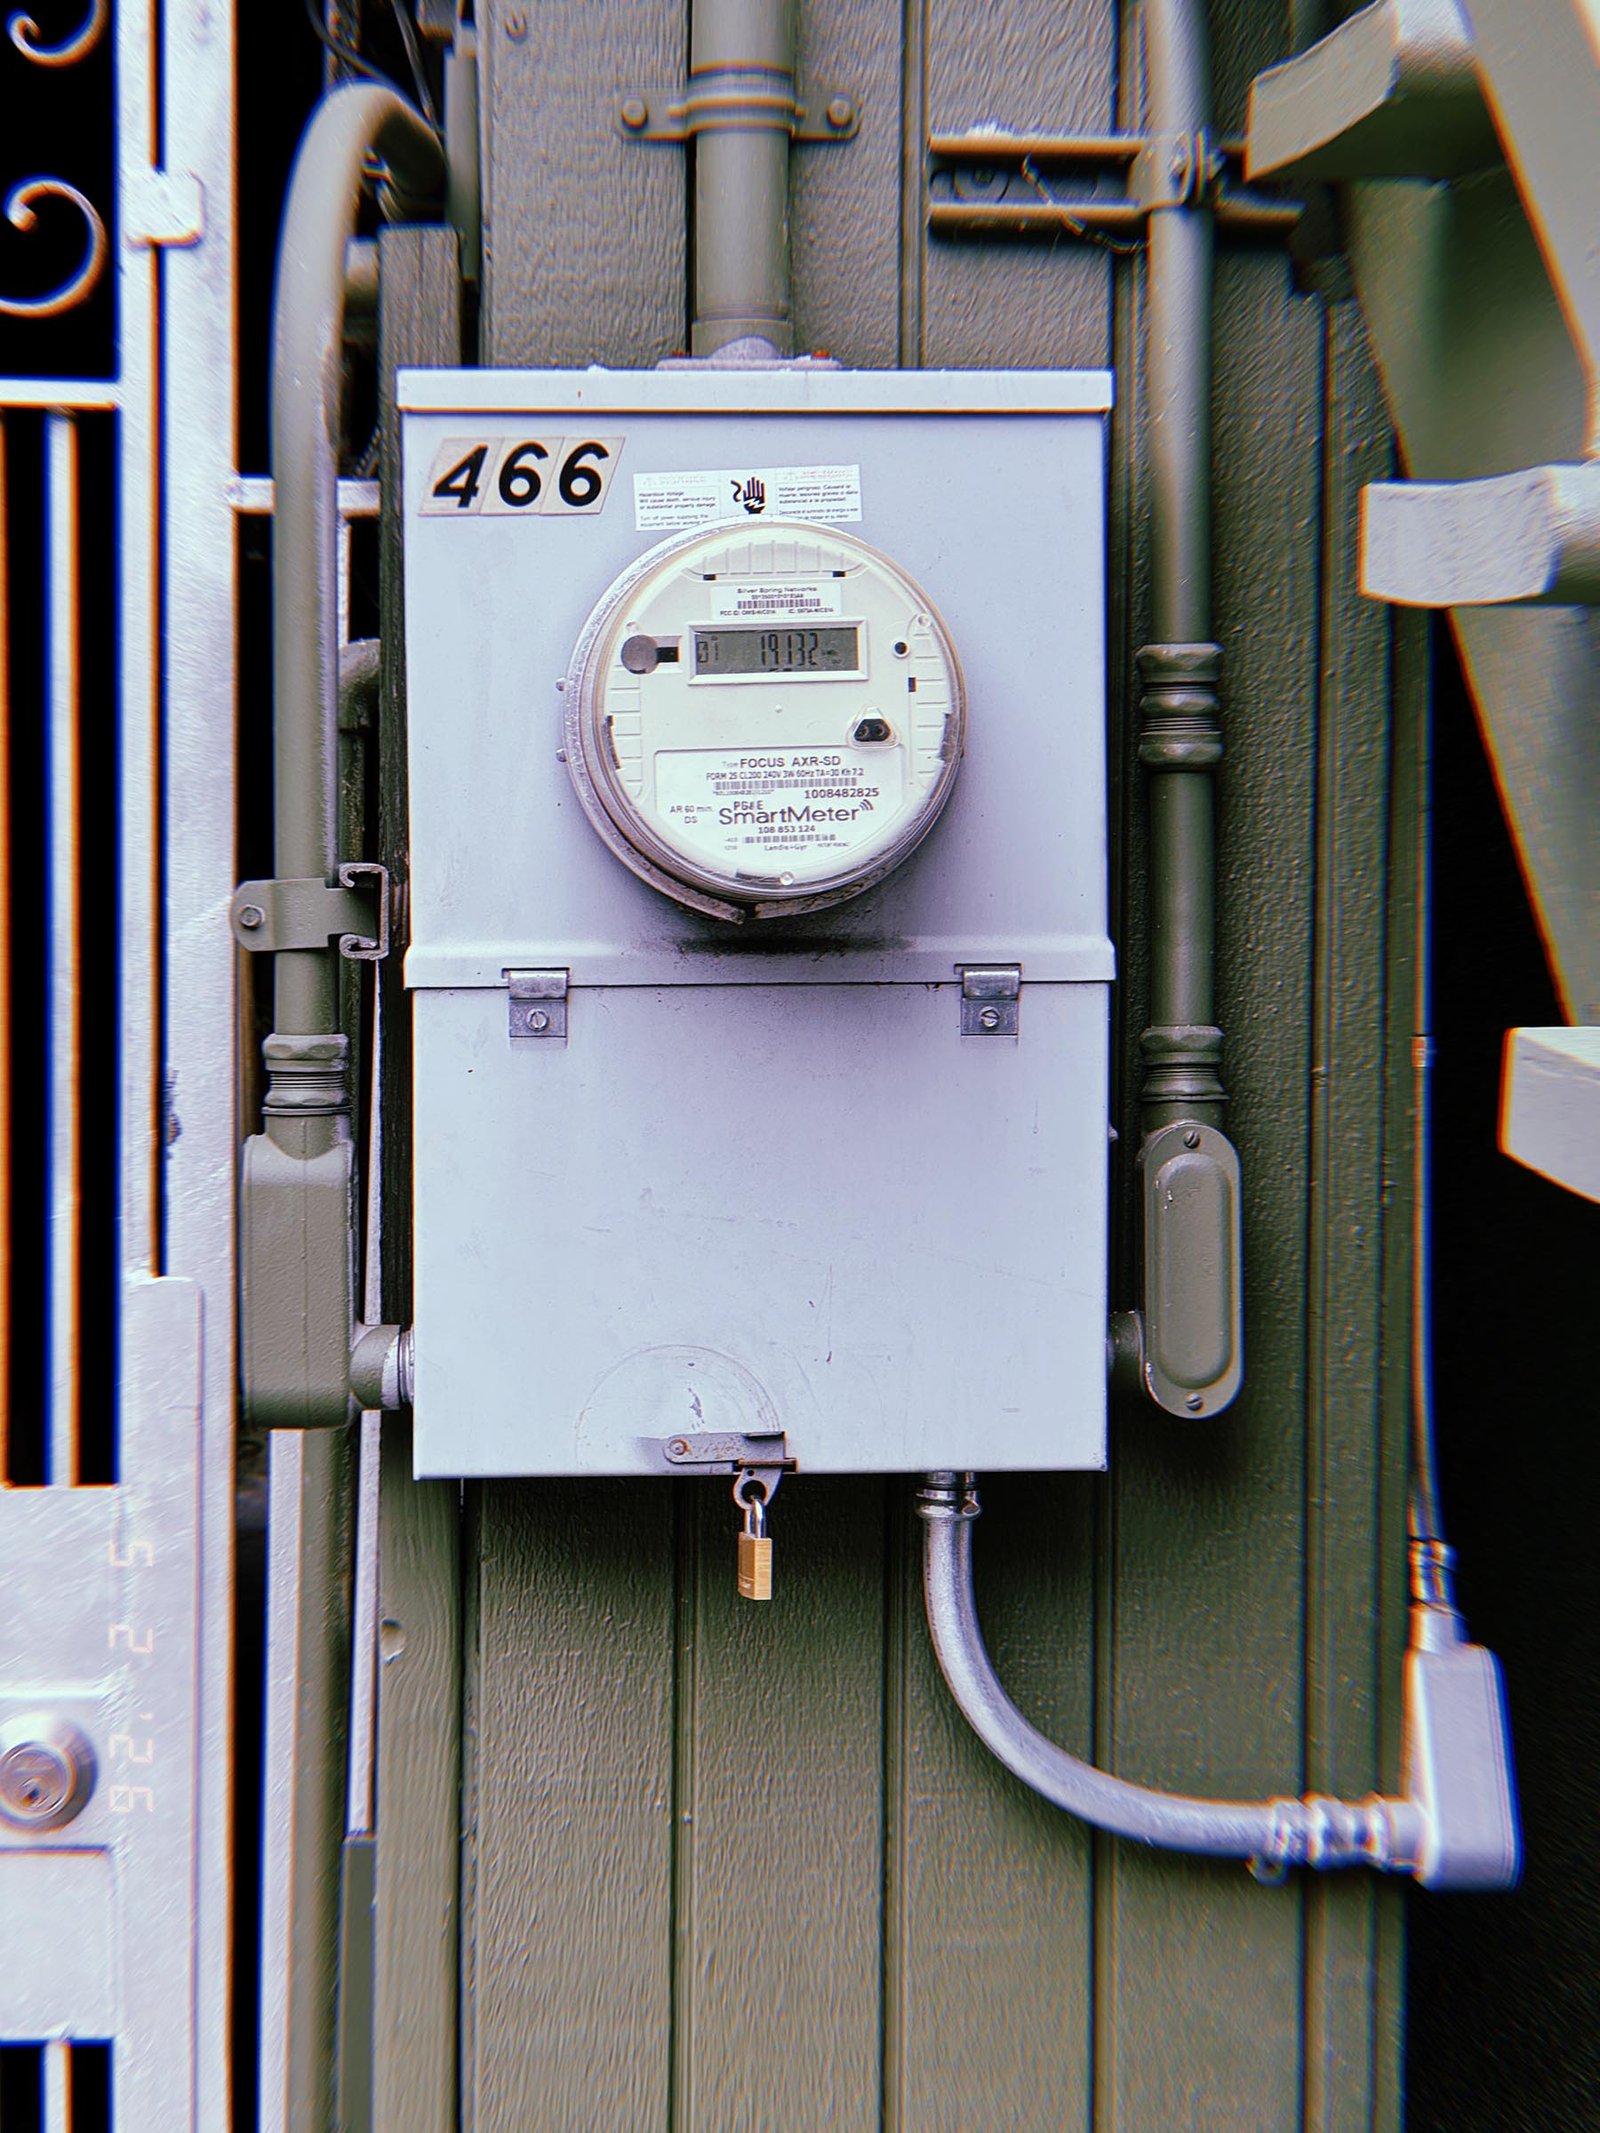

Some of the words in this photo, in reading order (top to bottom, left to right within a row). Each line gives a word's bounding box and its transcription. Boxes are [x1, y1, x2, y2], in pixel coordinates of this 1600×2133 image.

[432, 440, 609, 508] 466
[759, 586, 782, 594] Spring
[740, 758, 785, 769] FOCUS
[792, 755, 841, 767] AXR-SD
[804, 787, 879, 799] 1008482825
[684, 816, 698, 824] DS
[719, 806, 860, 825] SmartMeter
[758, 826, 775, 834] 108
[777, 825, 796, 833] 853
[798, 824, 816, 833] 124
